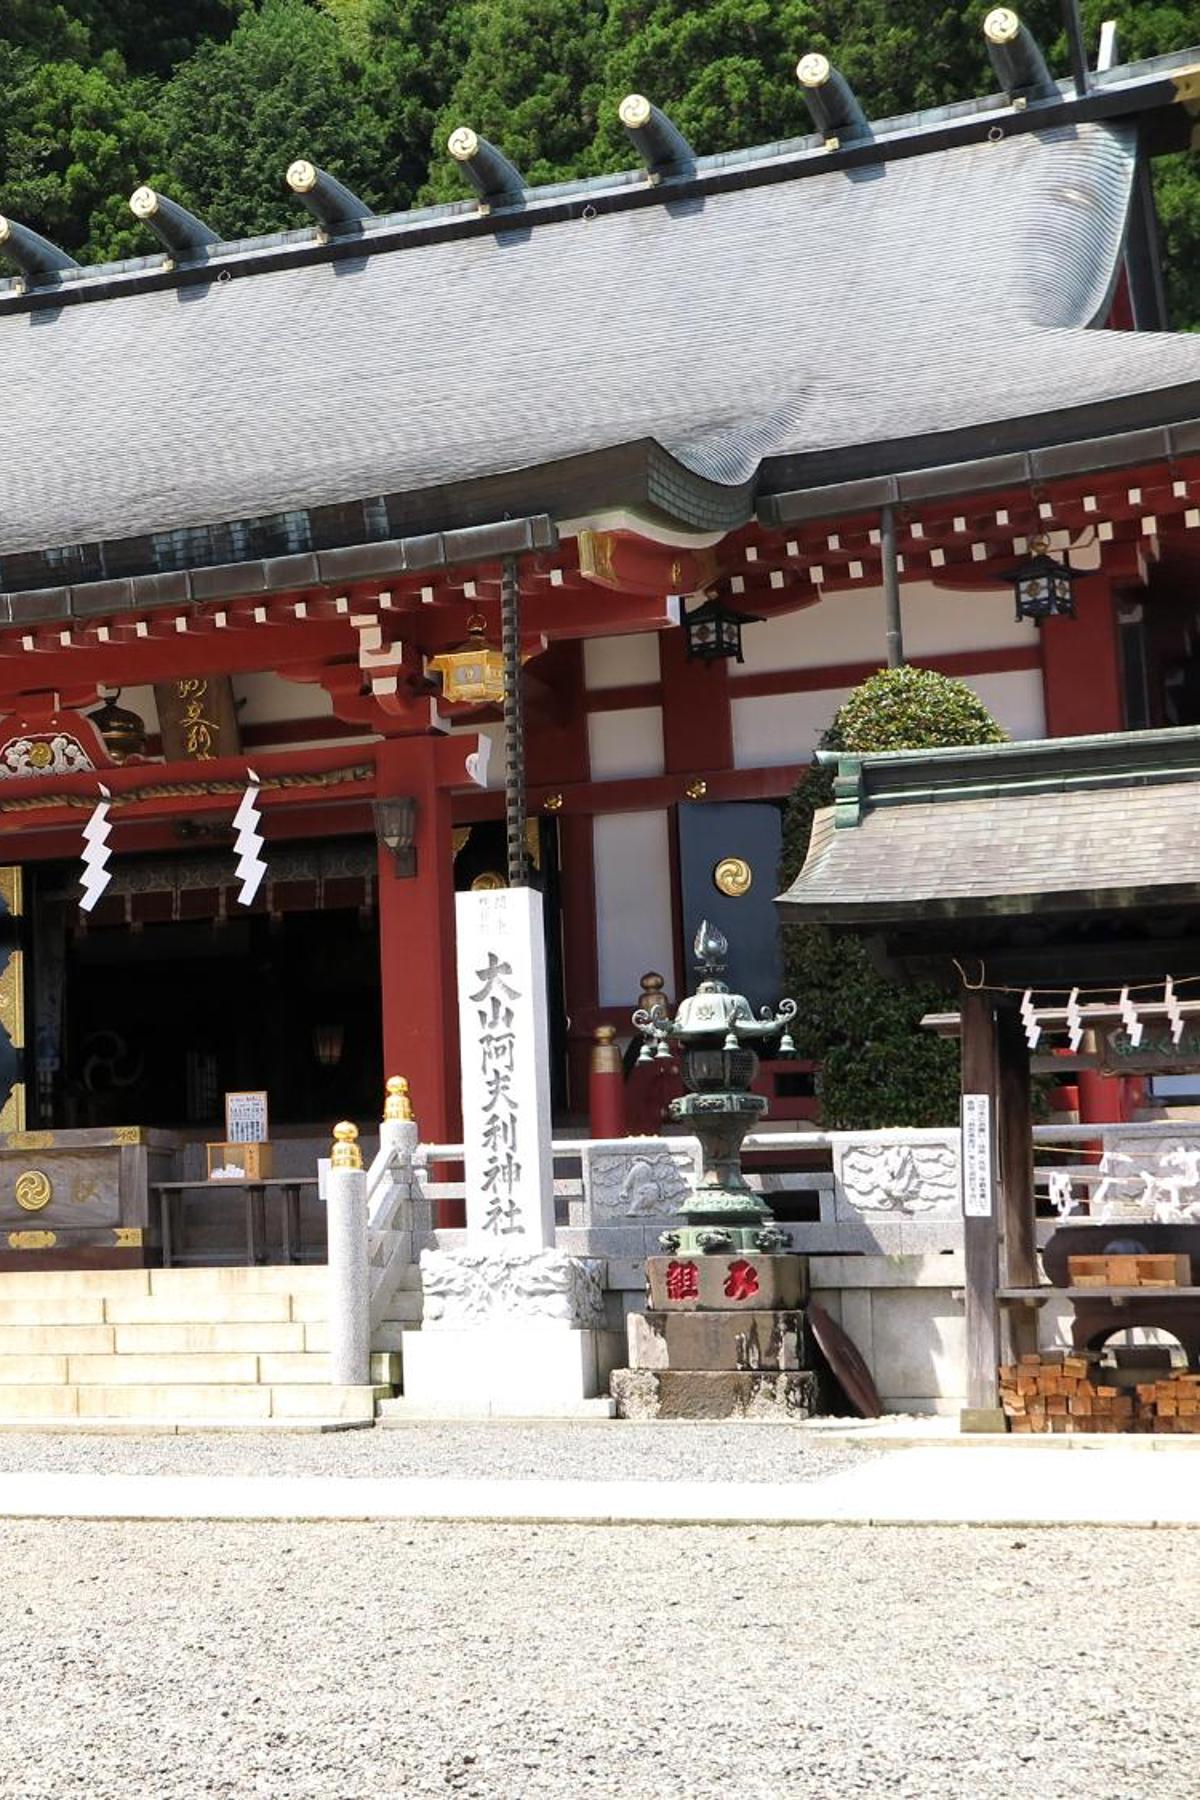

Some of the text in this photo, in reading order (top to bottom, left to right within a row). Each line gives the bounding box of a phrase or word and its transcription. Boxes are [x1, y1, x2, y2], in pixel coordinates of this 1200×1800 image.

[468, 951, 526, 1237] 大山阿夫利神社
